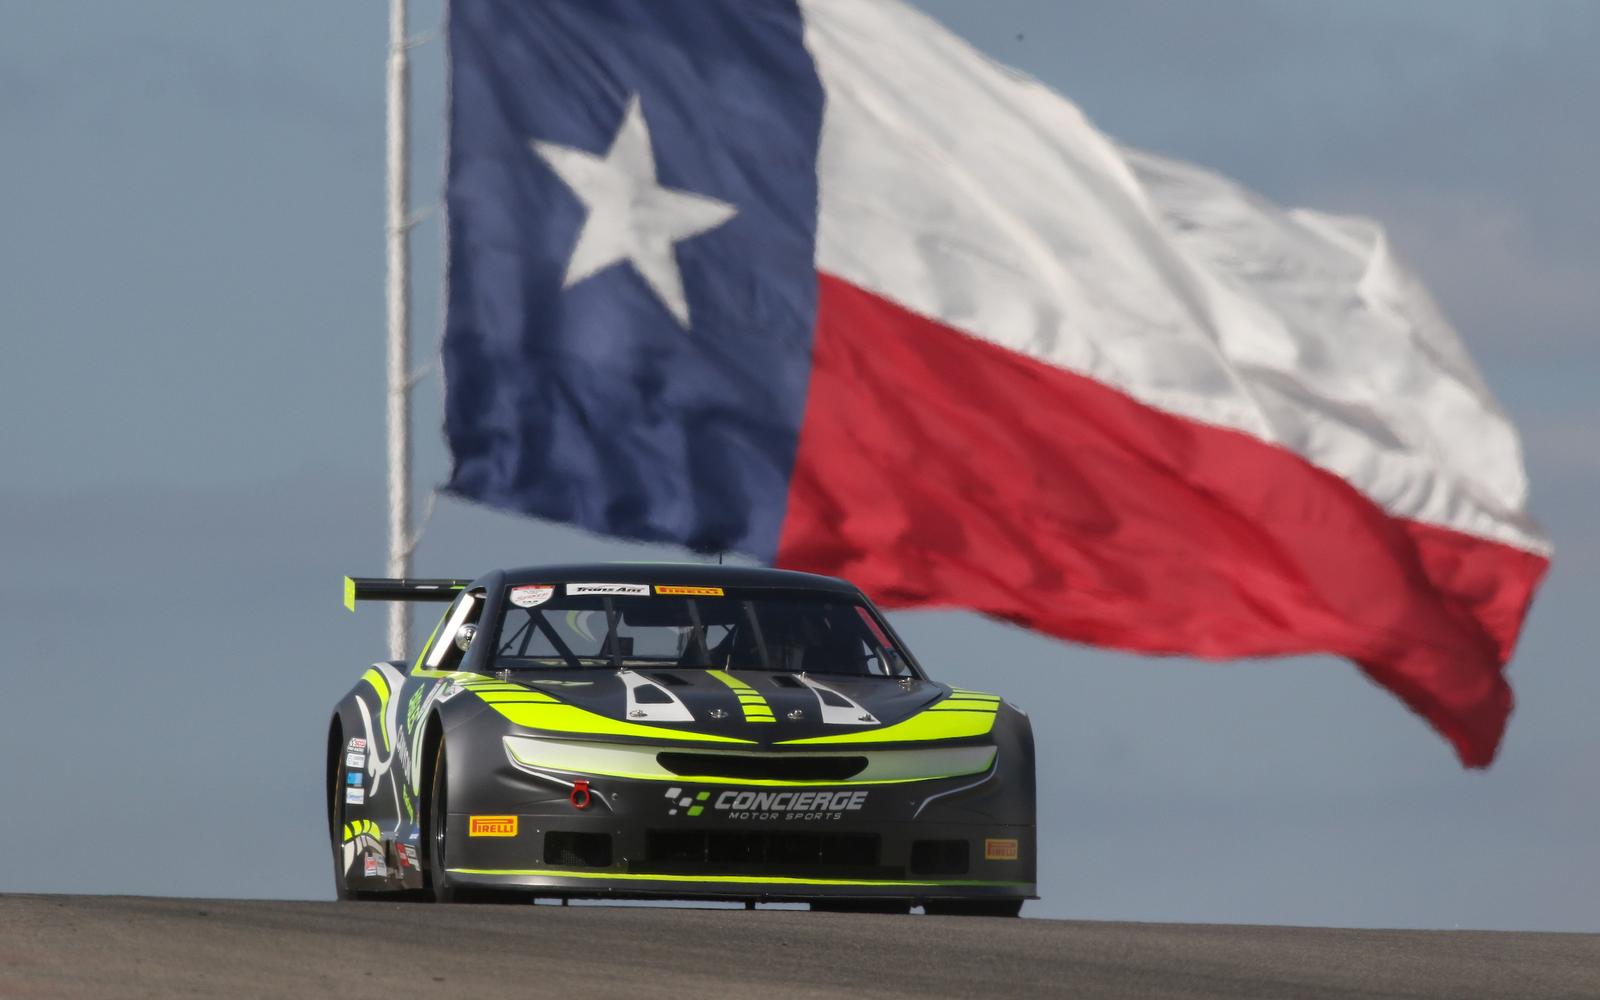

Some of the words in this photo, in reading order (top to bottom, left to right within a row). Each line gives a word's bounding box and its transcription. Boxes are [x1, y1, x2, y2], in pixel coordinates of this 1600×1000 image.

[658, 586, 719, 594] PIRELLI
[714, 791, 869, 811] CONCIERGE
[728, 812, 779, 820] MOTOR
[785, 812, 842, 821] SPORTS
[472, 818, 514, 833] PIRELLI
